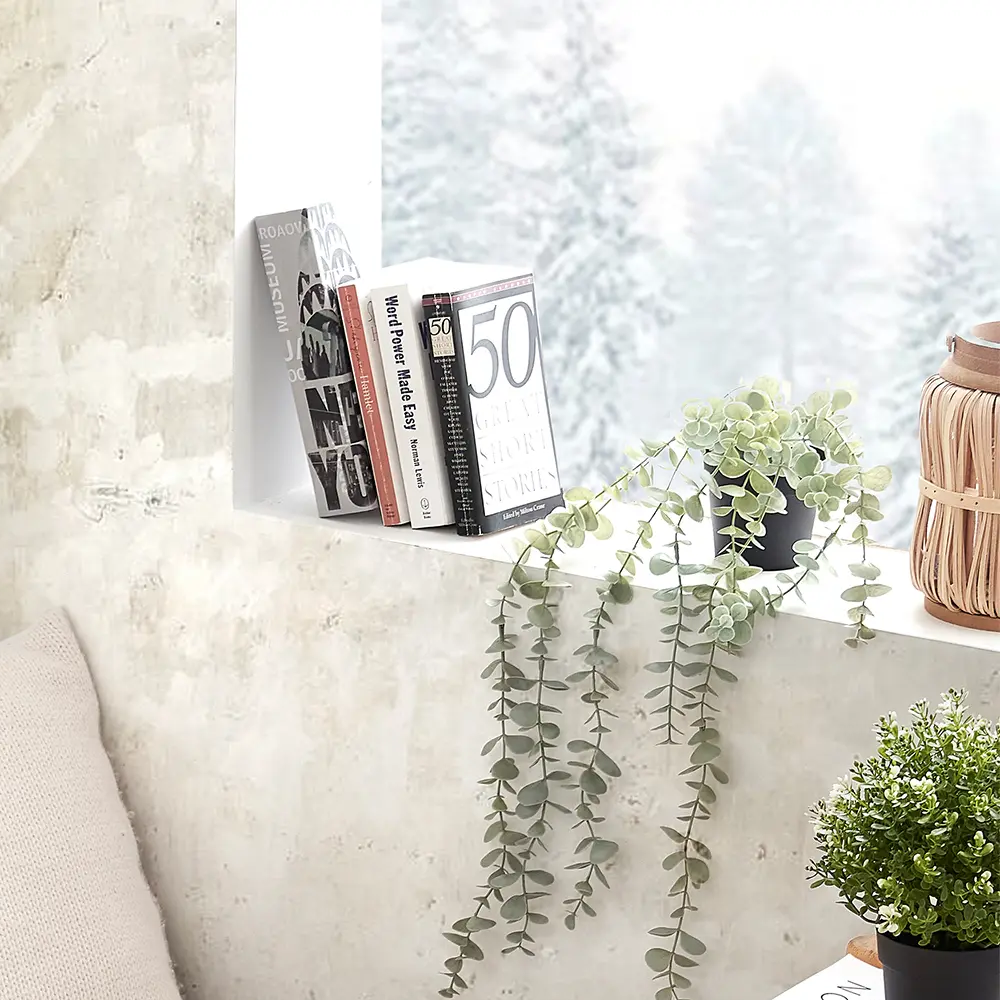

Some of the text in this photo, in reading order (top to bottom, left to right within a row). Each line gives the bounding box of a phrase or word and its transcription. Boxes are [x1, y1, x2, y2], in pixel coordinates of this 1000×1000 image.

[260, 243, 289, 333] MUSEUM
[430, 318, 451, 336] 50
[468, 301, 537, 399] 50
[360, 375, 374, 413] Hamlet
[384, 295, 417, 431] Word Power Made Easy
[410, 439, 421, 467] Norman
